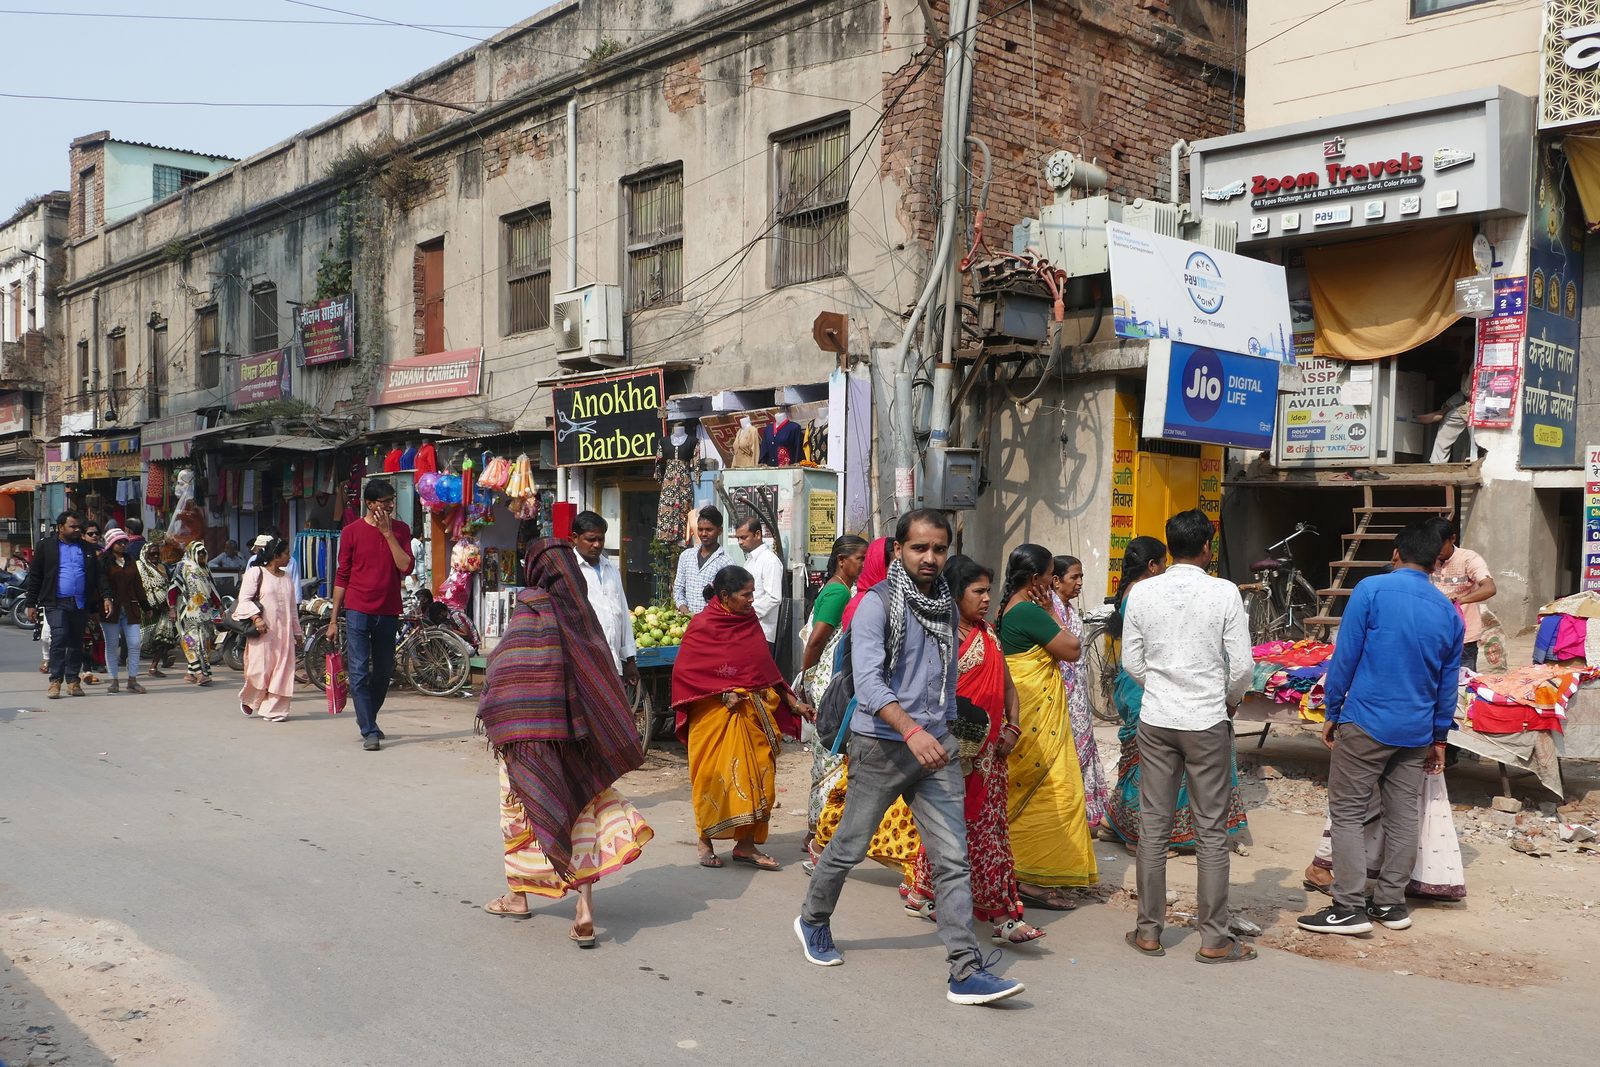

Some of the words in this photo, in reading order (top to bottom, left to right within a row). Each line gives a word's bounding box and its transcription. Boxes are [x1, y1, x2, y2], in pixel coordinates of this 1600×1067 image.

[1251, 172, 1319, 195] Zoom
[1326, 151, 1423, 185] Travels
[1262, 199, 1277, 207] Types
[1349, 184, 1367, 193] Adhar
[1367, 182, 1382, 190] Card,
[1383, 180, 1399, 188] Color
[1400, 177, 1417, 185] Prints
[1195, 260, 1210, 272] KYC
[1197, 294, 1216, 307] POINT
[1194, 316, 1207, 326] Zoom
[1208, 319, 1226, 329] Travels
[1529, 327, 1556, 371] कन्हैया
[1557, 344, 1575, 374] लाल
[388, 368, 425, 388] SADHANA
[426, 361, 469, 382] GARMENTS
[1186, 365, 1221, 401] Jio
[1229, 375, 1262, 393] DIGITAL
[571, 381, 658, 419] Anokha
[1227, 391, 1247, 405] LIFE
[1288, 397, 1340, 409] AVAILA
[1349, 427, 1365, 436] Jio
[578, 429, 656, 462] Barber
[1114, 450, 1133, 464] आय
[1201, 459, 1220, 472] आय
[1113, 466, 1133, 485] जाति
[1201, 475, 1218, 492] जाति
[1113, 488, 1133, 507] निवास
[1200, 495, 1219, 513] निवास
[1108, 557, 1122, 572] आधा
